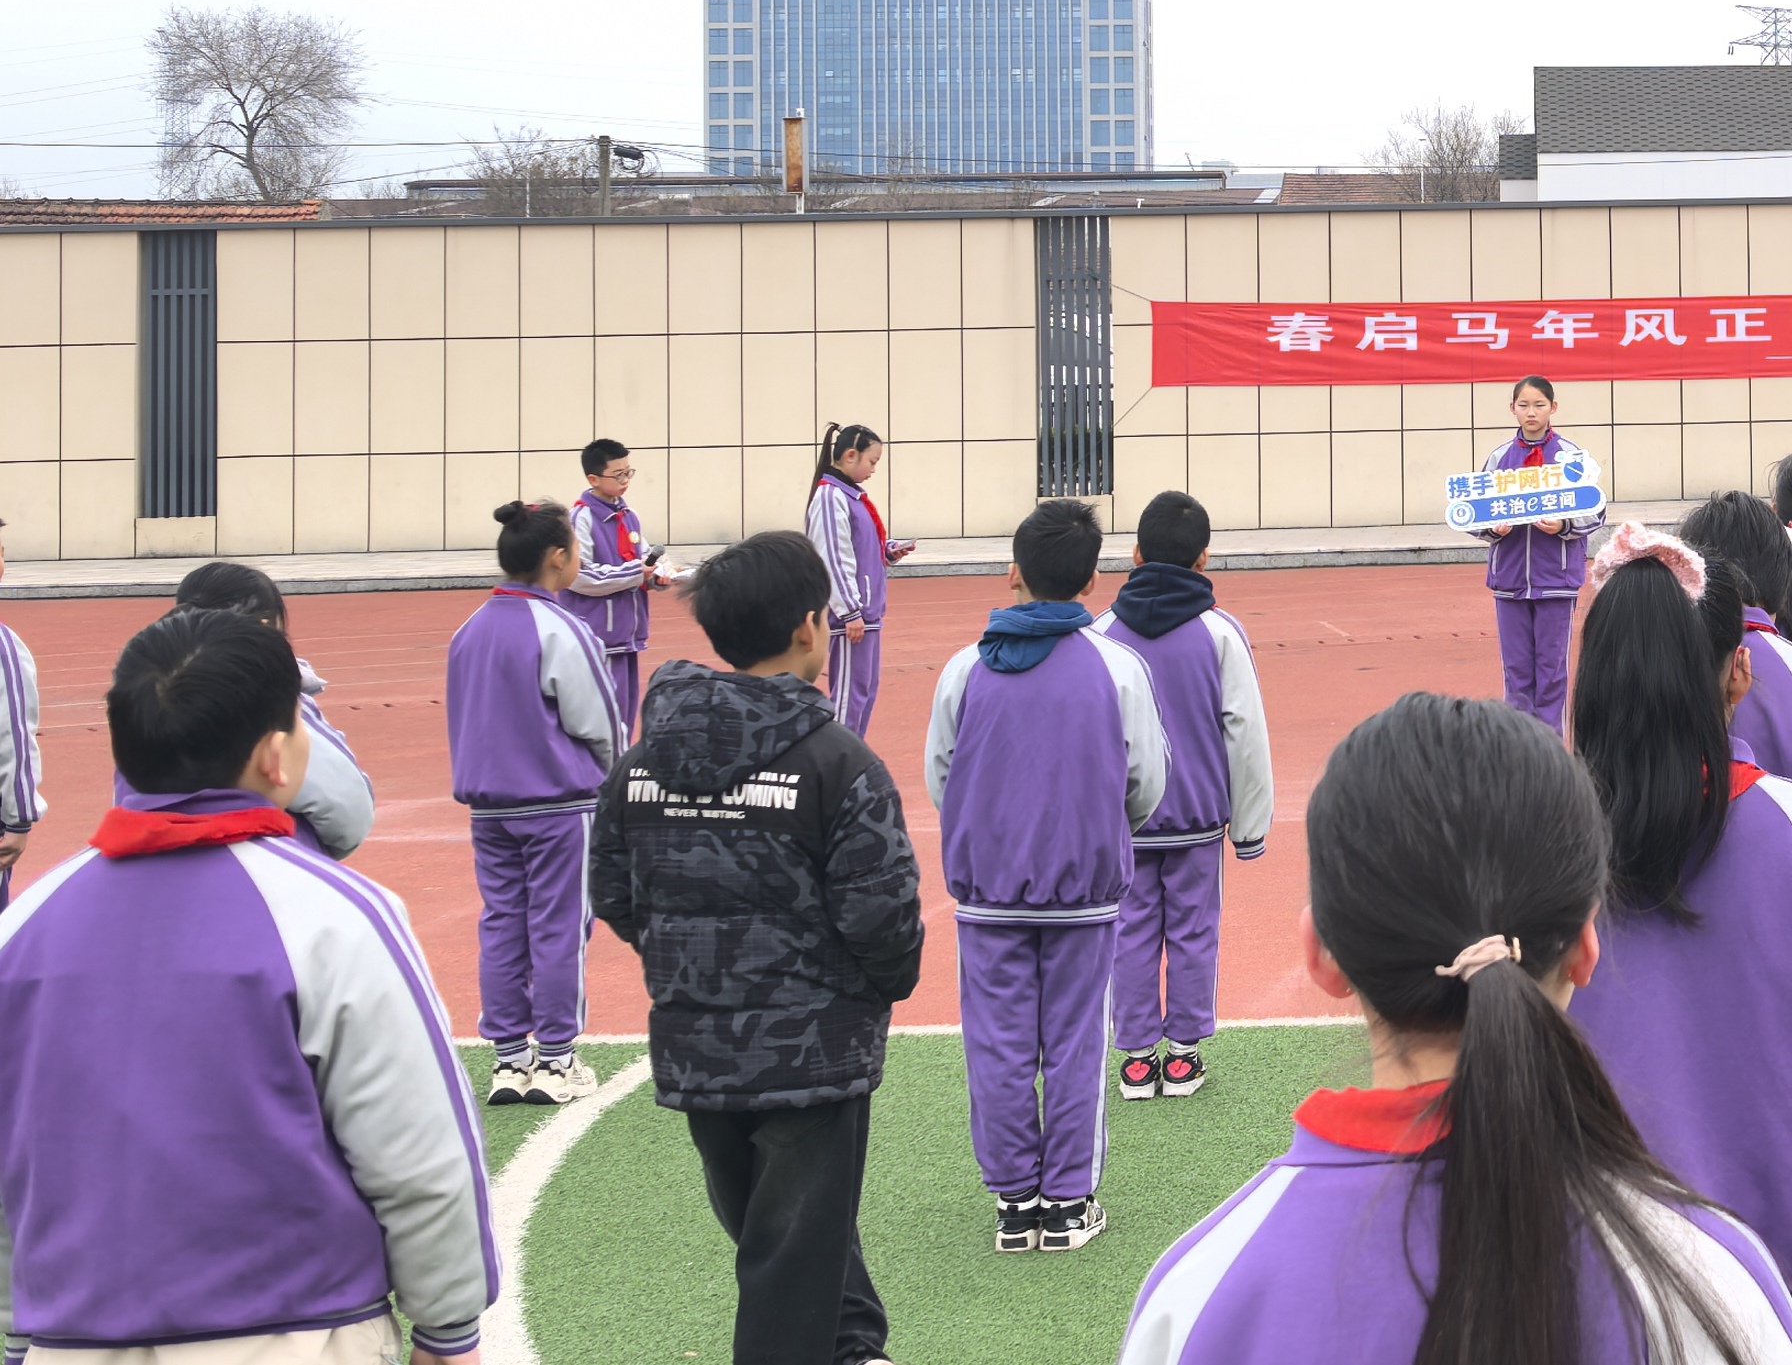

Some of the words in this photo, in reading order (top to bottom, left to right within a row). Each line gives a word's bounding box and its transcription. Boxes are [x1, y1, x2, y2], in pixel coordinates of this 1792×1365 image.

[1448, 465, 1562, 499] 携手护网行
[1490, 491, 1576, 517] 共治e空间
[663, 807, 698, 818] NEVER
